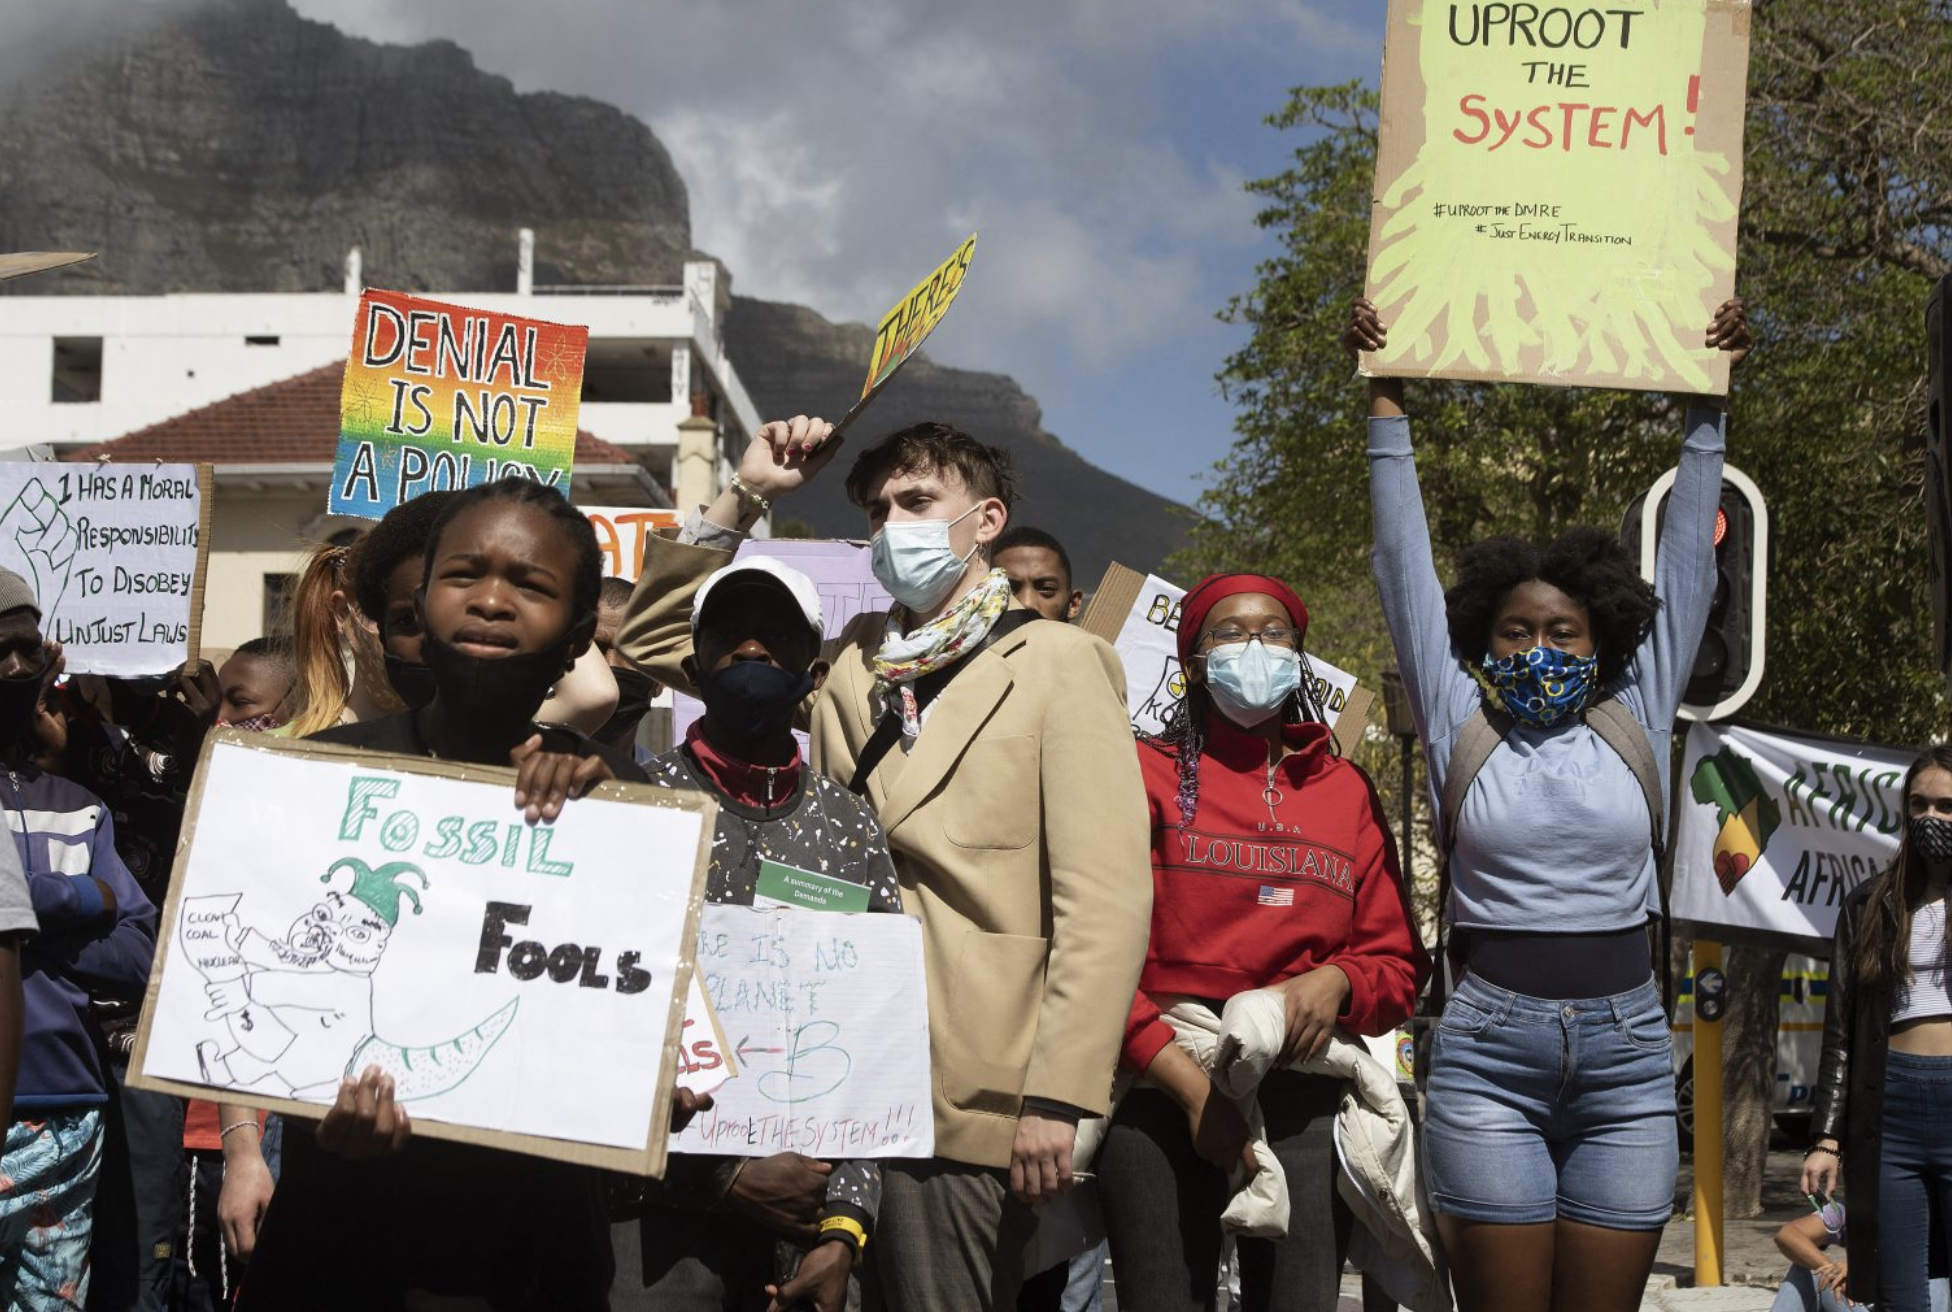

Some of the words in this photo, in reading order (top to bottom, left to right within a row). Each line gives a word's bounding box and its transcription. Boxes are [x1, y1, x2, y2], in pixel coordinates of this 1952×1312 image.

[1449, 2, 1644, 49] UPROOT
[1521, 61, 1590, 88] THE
[362, 300, 551, 391] DENIAL
[385, 378, 433, 437] IS
[452, 390, 547, 449] NOT
[78, 472, 117, 501] HAS
[121, 474, 134, 501] A
[140, 473, 194, 501] MORAL
[341, 441, 380, 503] A
[396, 445, 563, 506] POL
[74, 566, 104, 598] TO
[113, 565, 191, 597] DISOBEY
[55, 614, 137, 646] UNJUST
[138, 611, 187, 645] LAWS
[338, 775, 575, 877] FOSSIL
[791, 878, 823, 893] summary
[1185, 834, 1354, 893] LOUISIANA
[185, 928, 219, 940] COAL
[474, 899, 653, 995] FOOLS
[814, 936, 858, 972] NO
[756, 1020, 852, 1104] B
